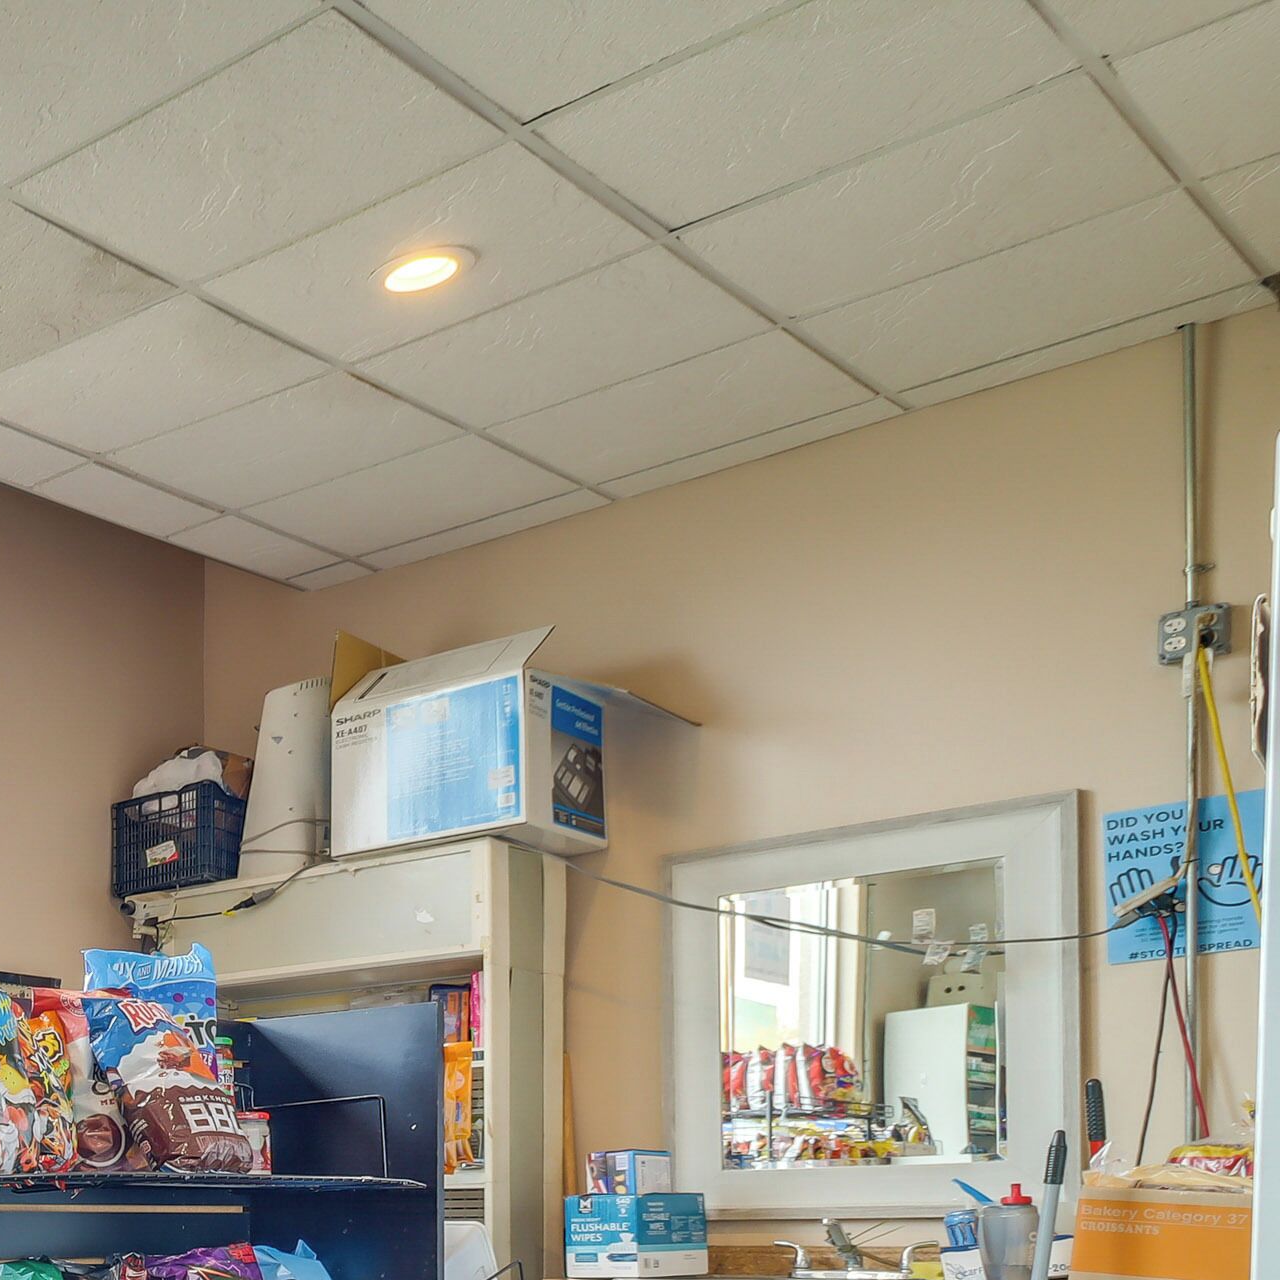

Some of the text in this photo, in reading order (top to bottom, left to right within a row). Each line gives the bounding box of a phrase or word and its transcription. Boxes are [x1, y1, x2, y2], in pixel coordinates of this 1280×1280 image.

[335, 709, 381, 726] SHARP
[1107, 809, 1184, 830] DID YOU
[1108, 828, 1165, 846] WASH
[1108, 842, 1184, 862] HANDS?
[1080, 1205, 1248, 1226] Bakery Category 37
[571, 1223, 631, 1232] FLUSHABLE
[1080, 1221, 1160, 1235] CROISSANTS
[571, 1233, 602, 1241] WIPES
